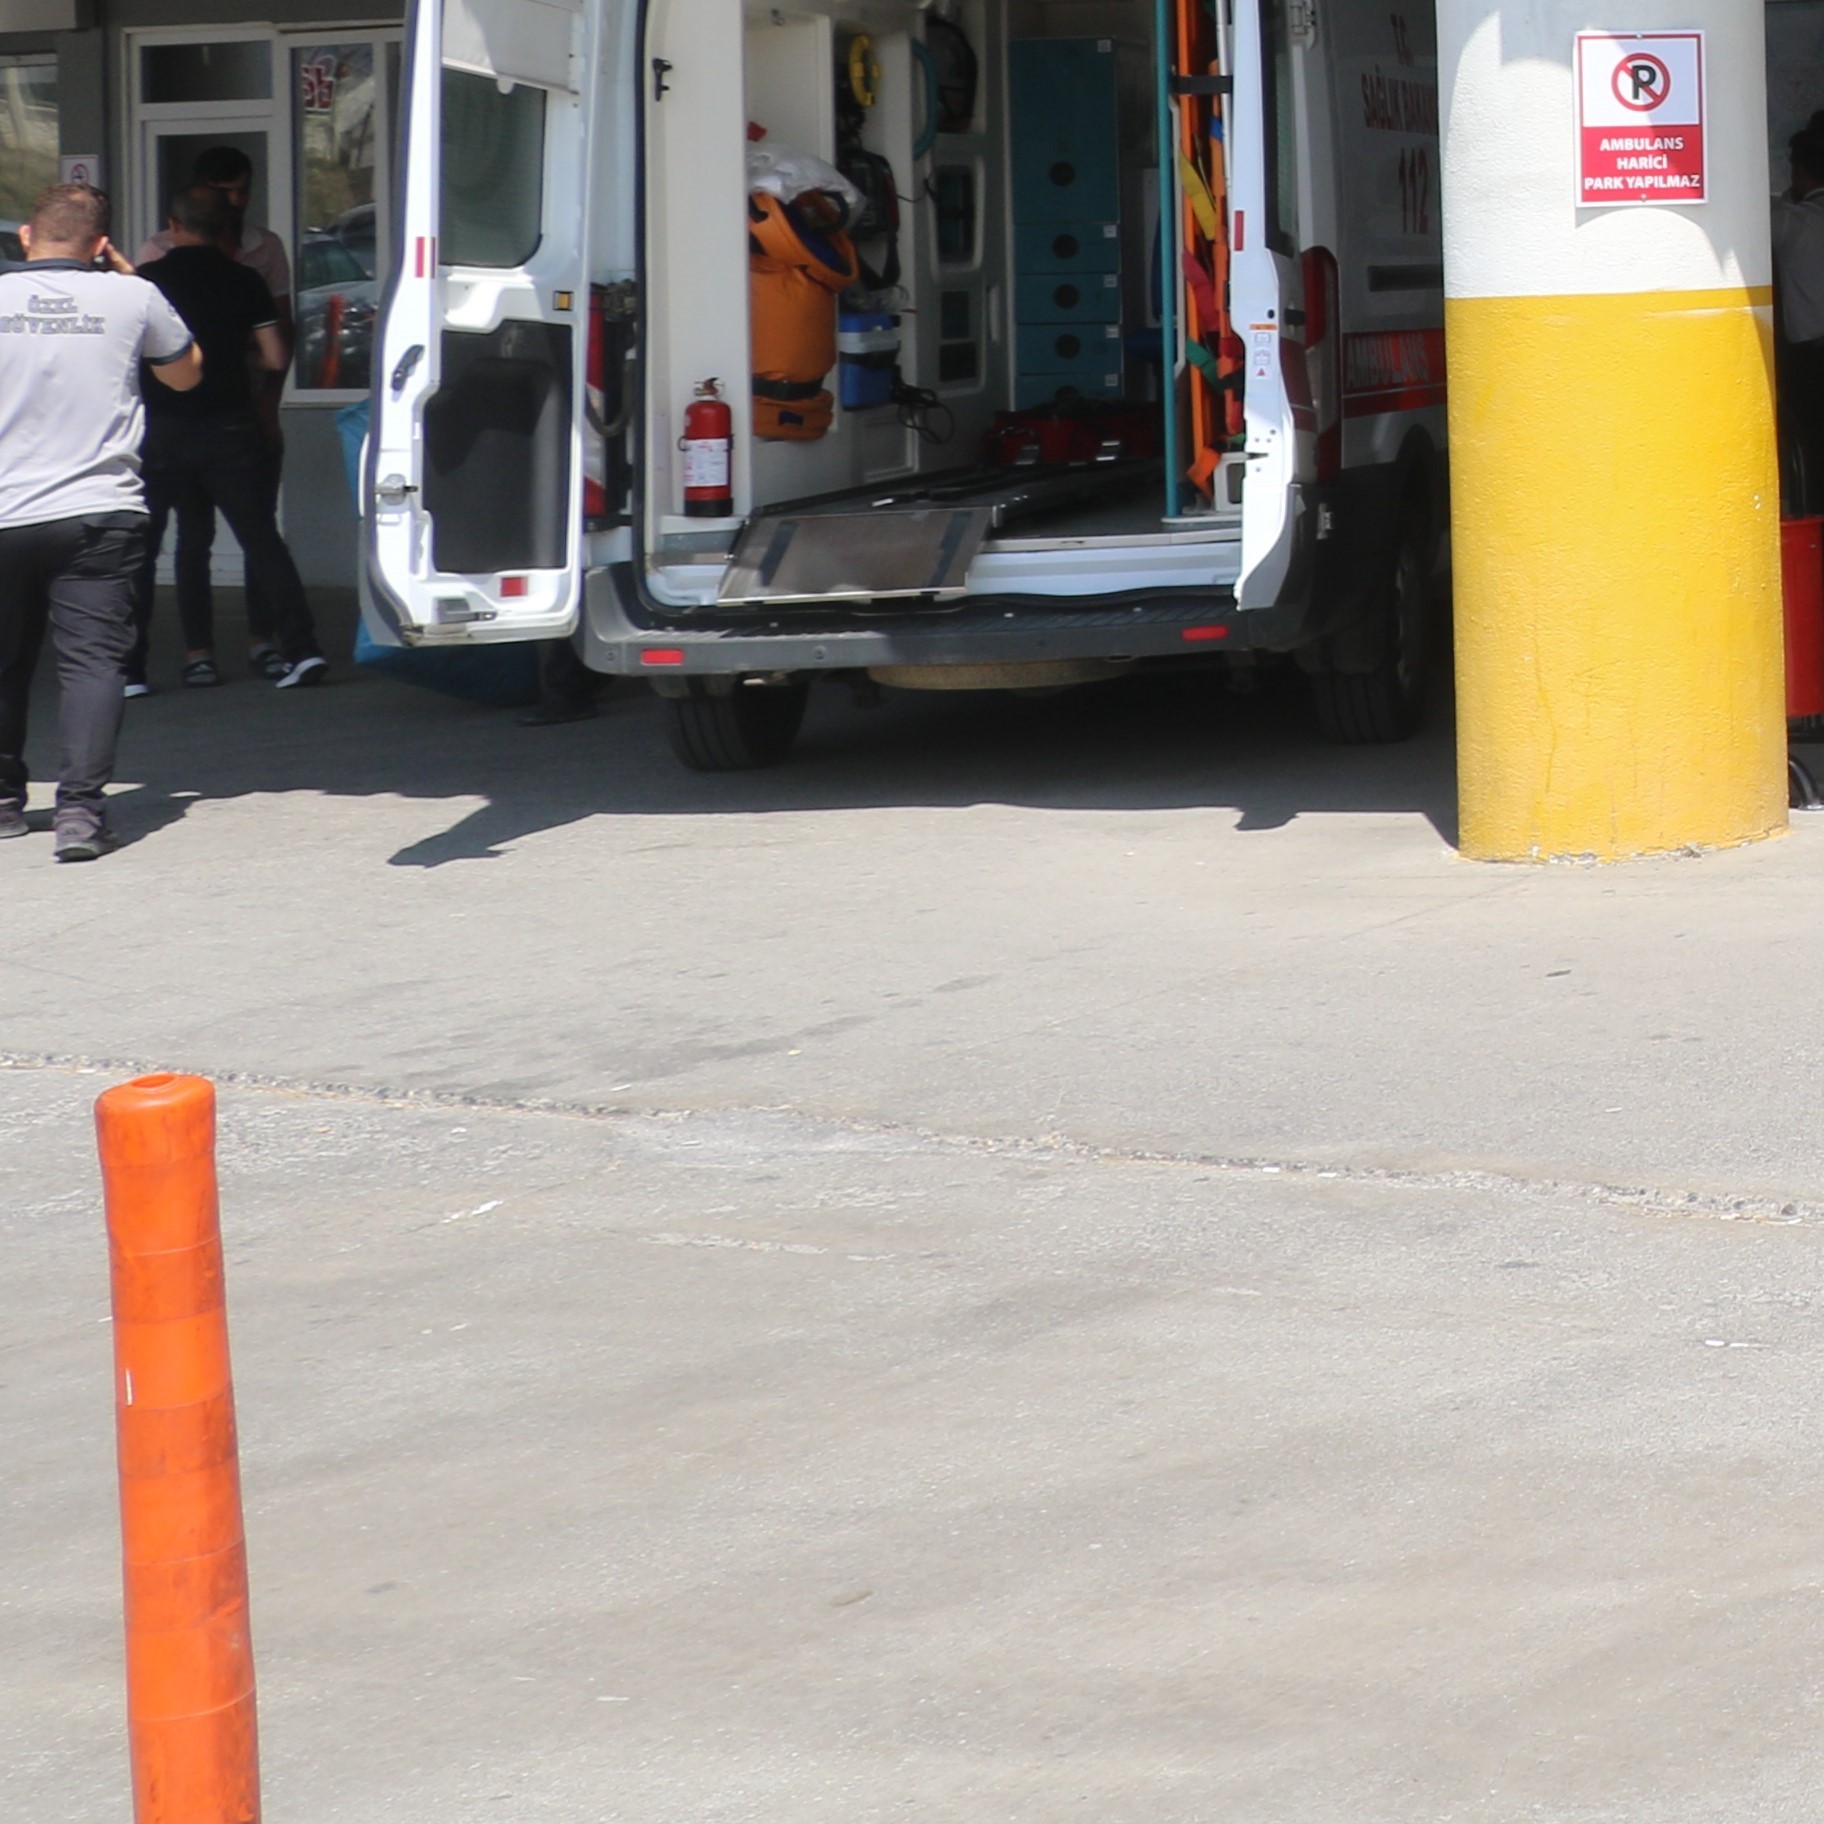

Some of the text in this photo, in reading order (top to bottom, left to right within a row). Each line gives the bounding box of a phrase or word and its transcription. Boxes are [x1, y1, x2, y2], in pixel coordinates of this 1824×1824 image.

[1600, 137, 1684, 151] AMBULANS
[1617, 154, 1668, 170] HARİCİ
[1398, 147, 1428, 233] 112
[1584, 175, 1700, 190] PARK YAPILMAZ
